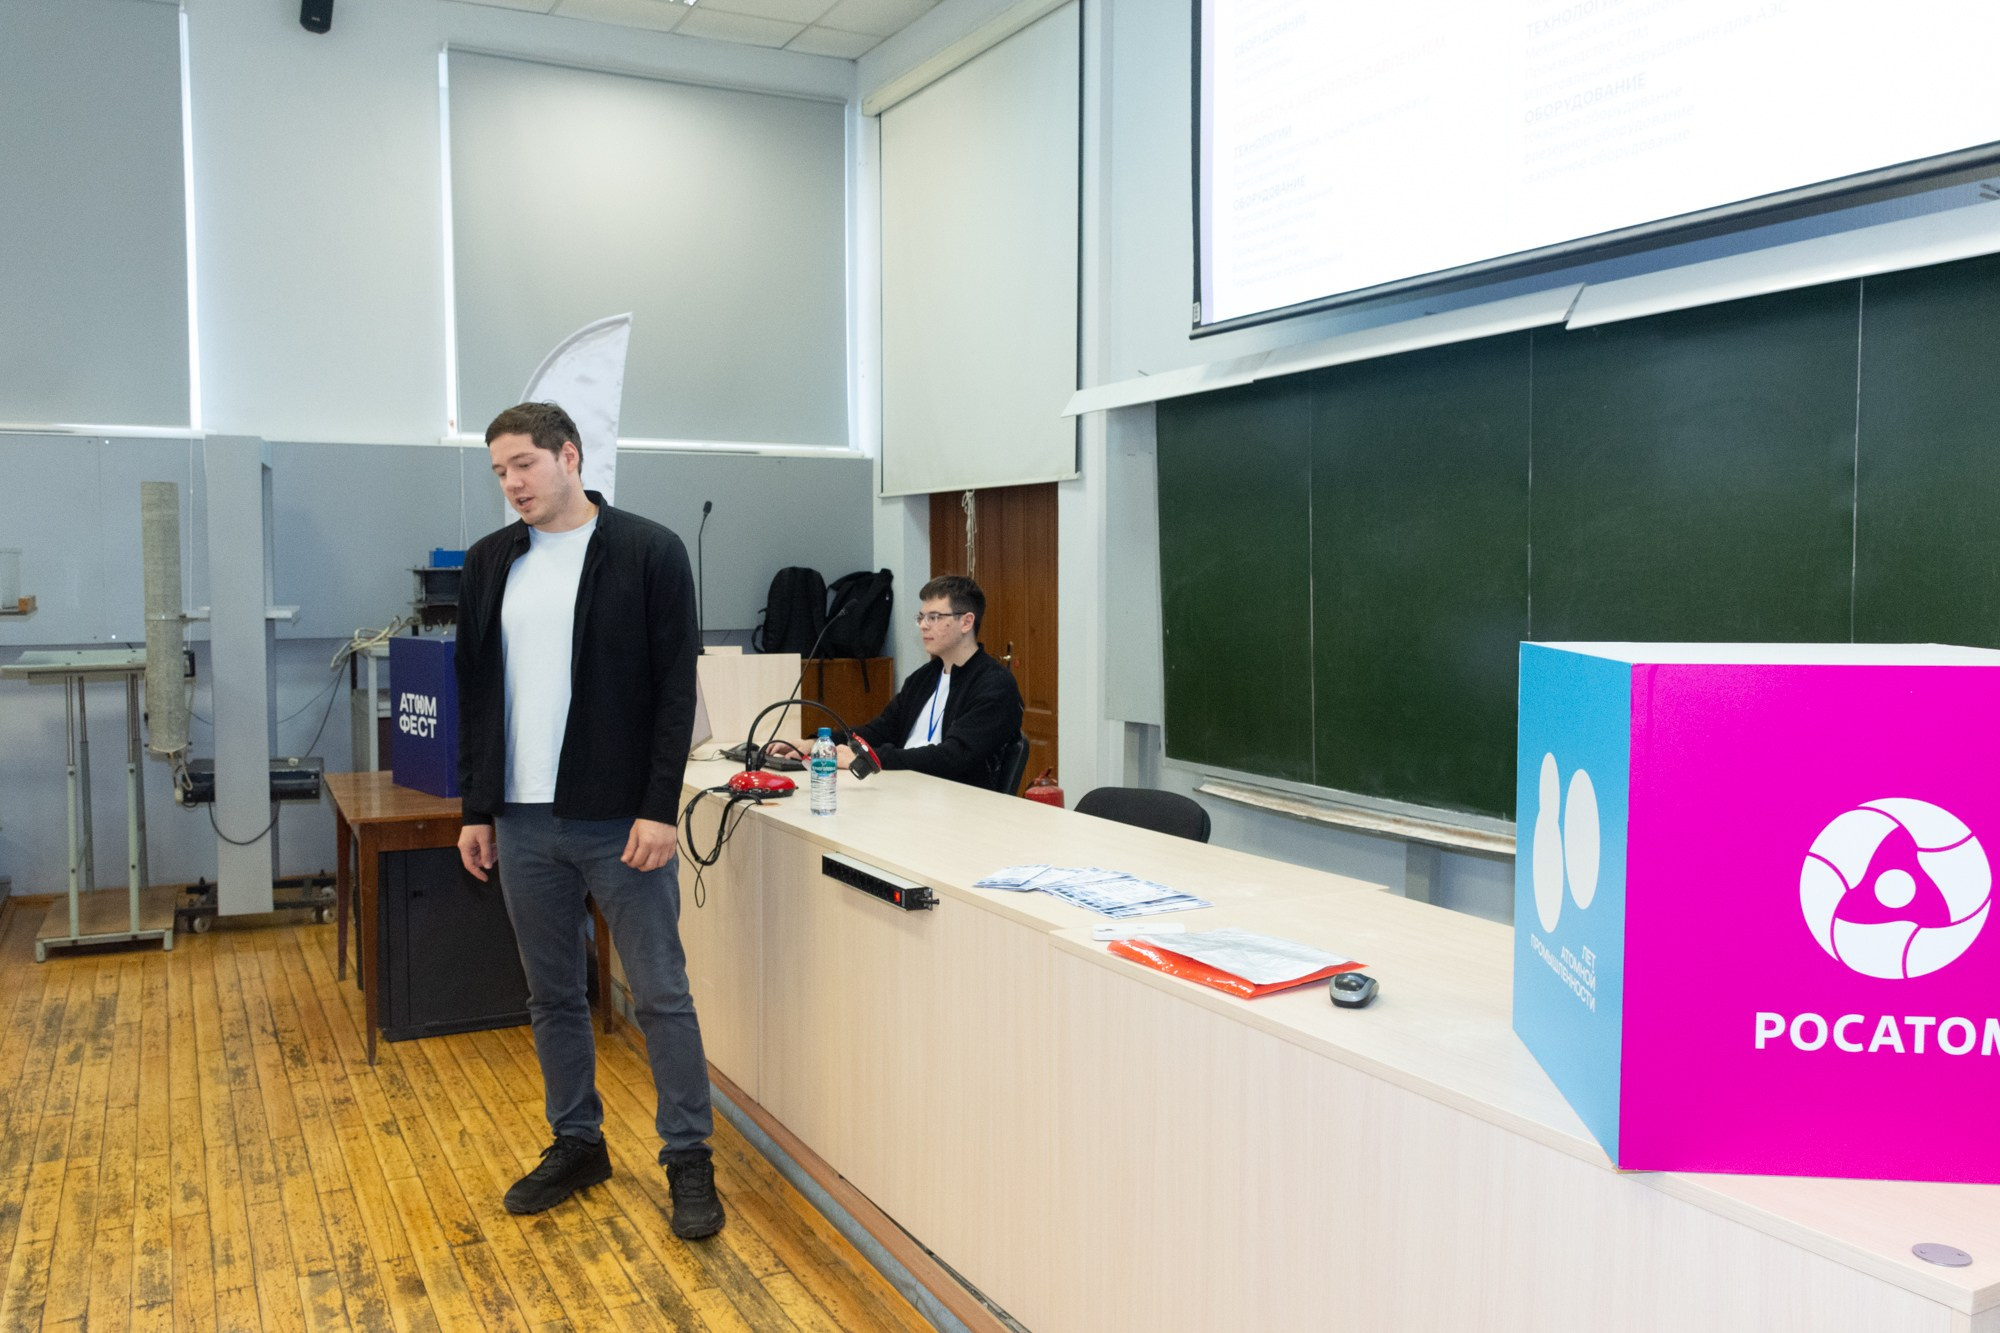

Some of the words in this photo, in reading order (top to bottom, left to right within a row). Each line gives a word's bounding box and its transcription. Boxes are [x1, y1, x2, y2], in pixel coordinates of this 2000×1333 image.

[1524, 71, 1646, 125] ОБОРУДОВАНИЕ
[1232, 174, 1305, 211] ОБОРУДОВАНИЕ
[399, 713, 437, 739] ФЕСТ
[1560, 946, 1597, 992] АТОМНОЙ
[1581, 944, 1597, 971] ЛЕТ
